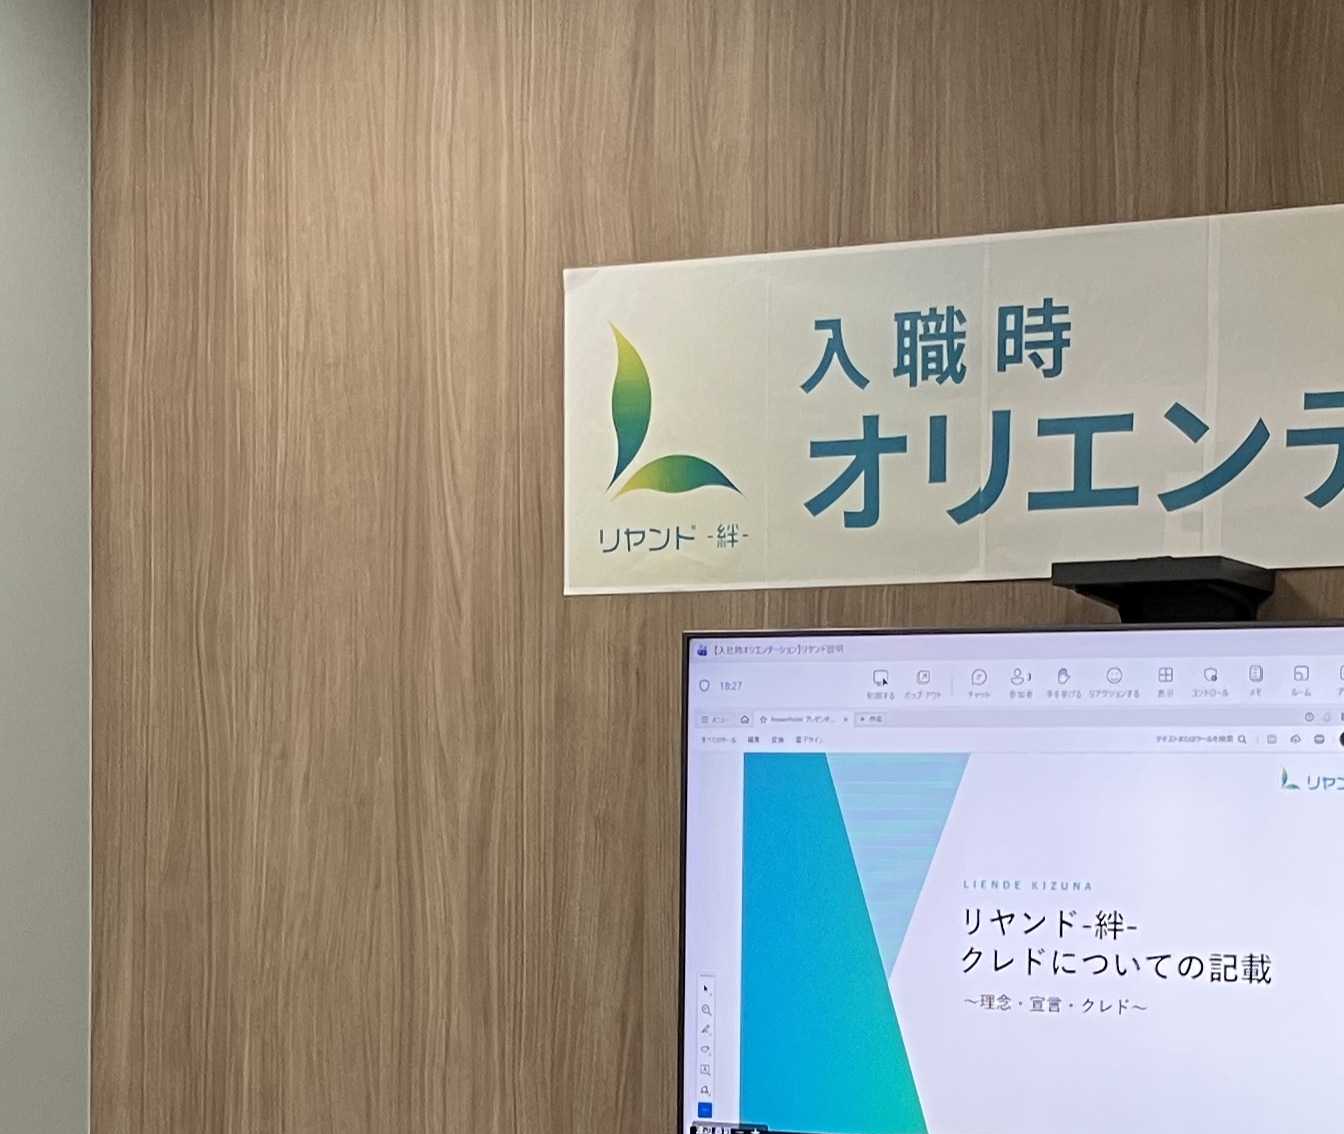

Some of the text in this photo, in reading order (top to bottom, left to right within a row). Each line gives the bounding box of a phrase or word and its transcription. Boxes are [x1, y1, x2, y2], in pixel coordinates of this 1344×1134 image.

[799, 297, 1072, 394] 入職時
[599, 525, 697, 553] リヤンド
[720, 681, 743, 691] 18:27
[963, 880, 1093, 892] LIENDE KIZUNA
[965, 908, 1137, 940] リヤンド-絆-
[962, 946, 1272, 985] クレドについての記載
